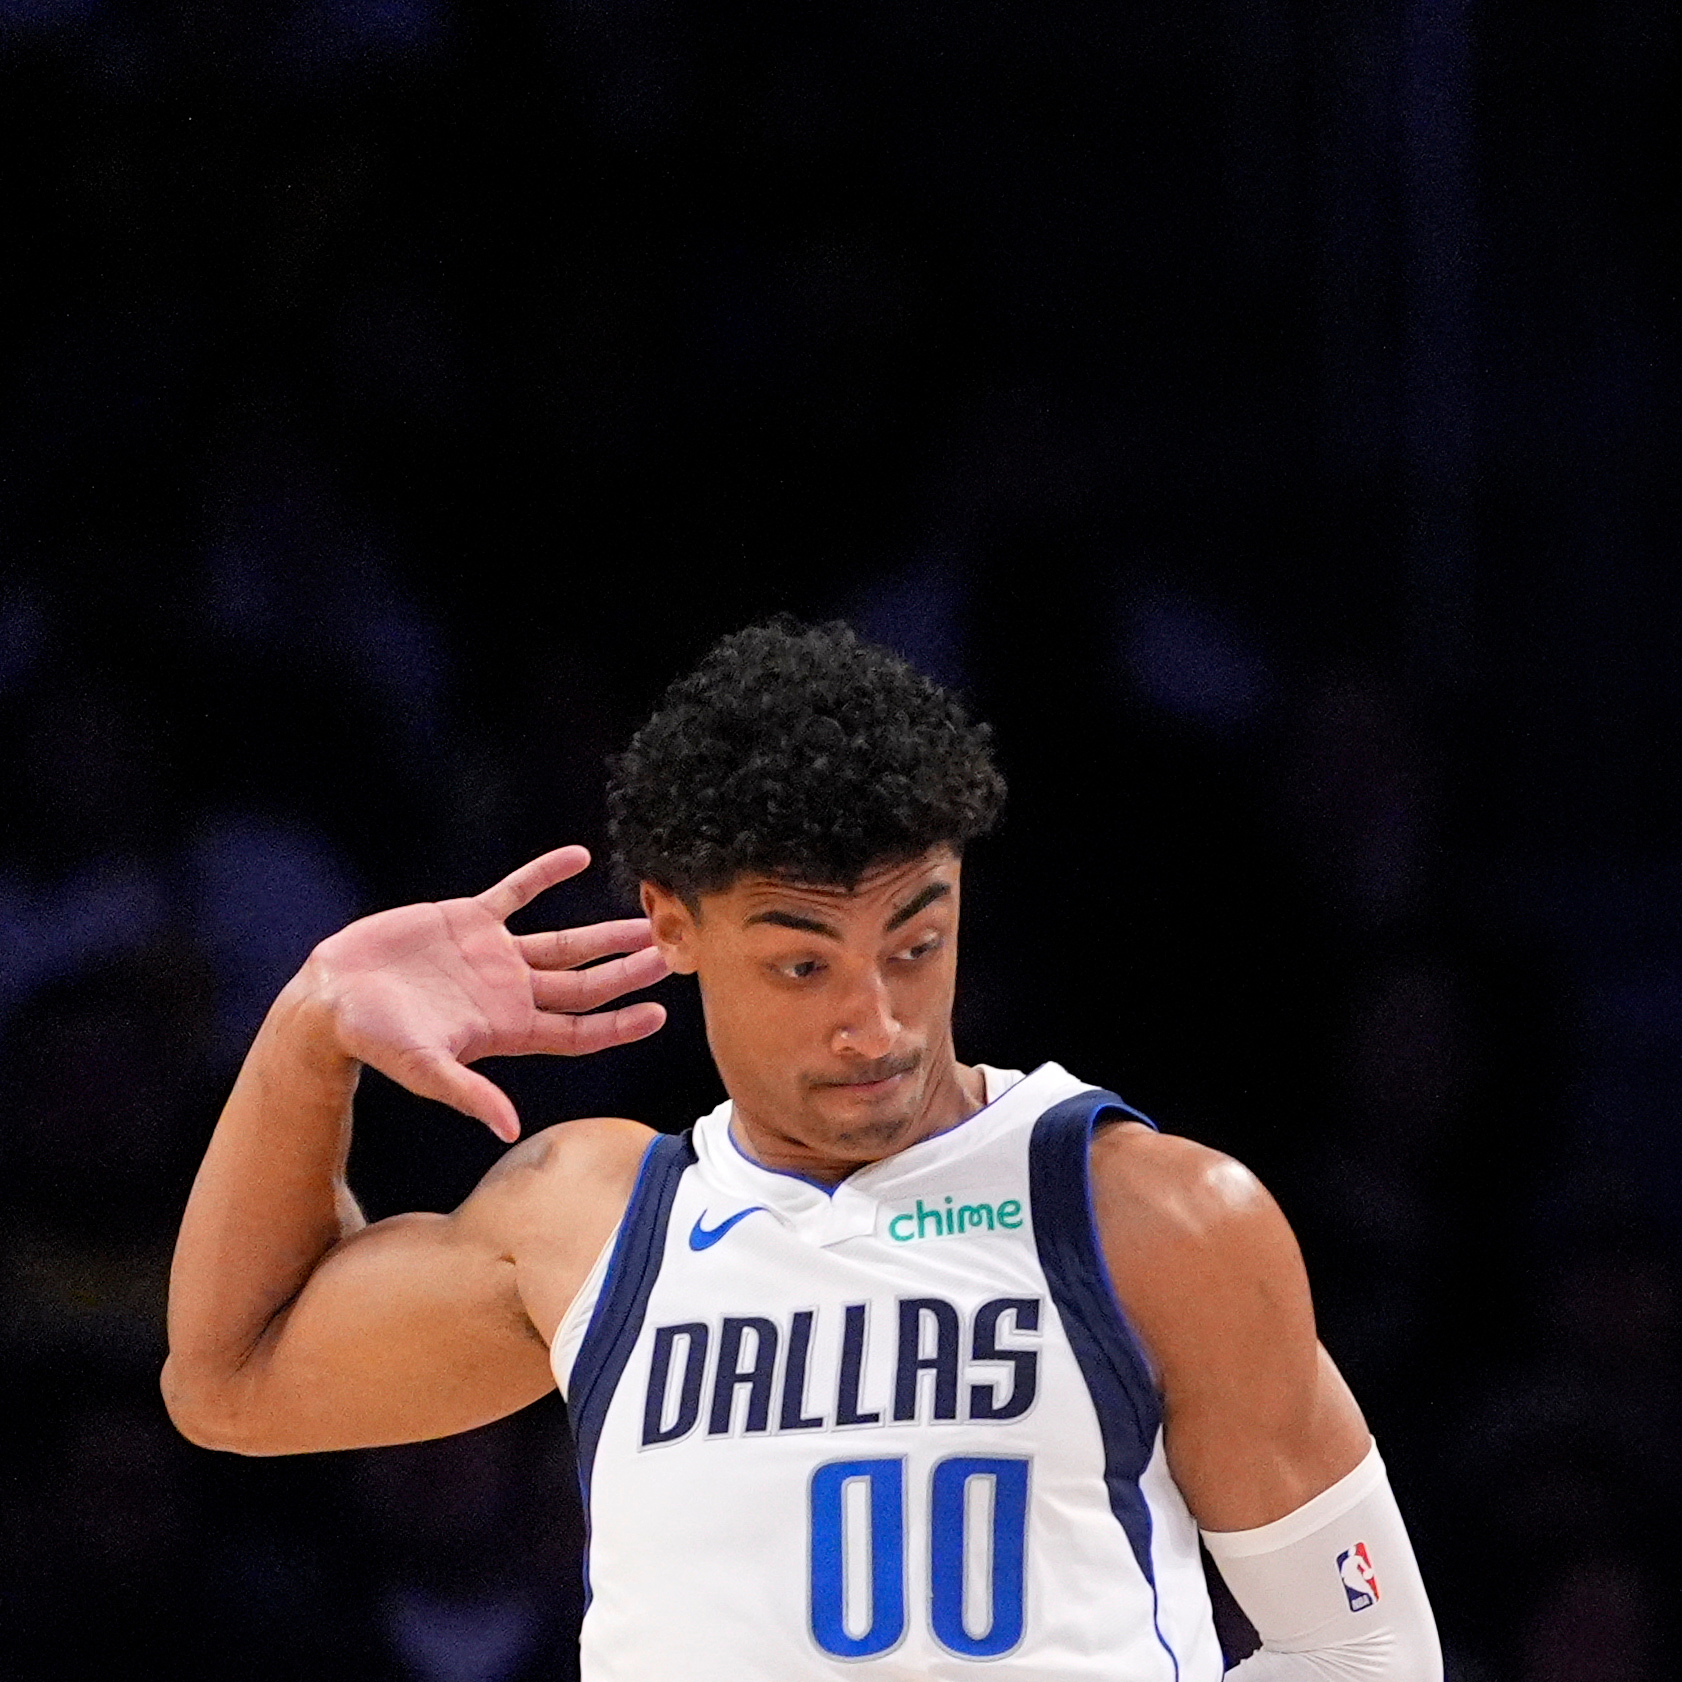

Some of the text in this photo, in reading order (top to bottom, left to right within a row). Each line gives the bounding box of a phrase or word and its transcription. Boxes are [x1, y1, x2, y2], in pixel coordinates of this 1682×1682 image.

[888, 1196, 1023, 1242] chime
[638, 1297, 1044, 1452] DALLAS
[806, 1453, 1035, 1663] 00
